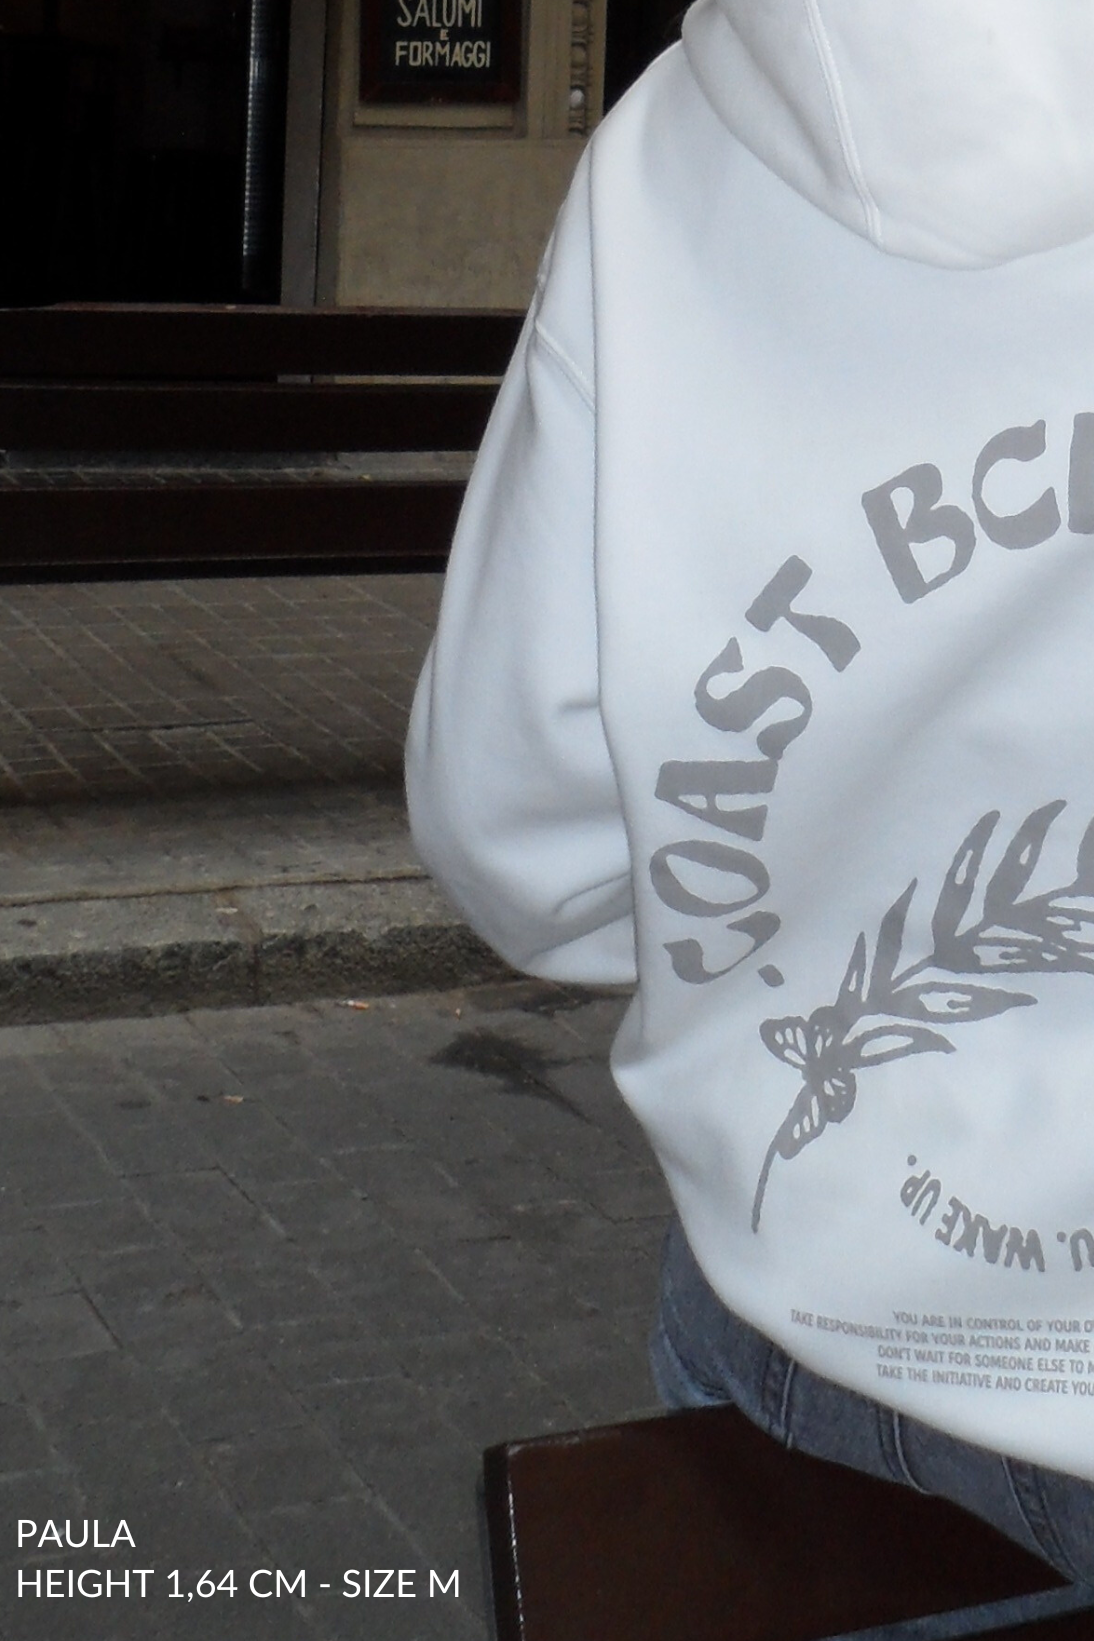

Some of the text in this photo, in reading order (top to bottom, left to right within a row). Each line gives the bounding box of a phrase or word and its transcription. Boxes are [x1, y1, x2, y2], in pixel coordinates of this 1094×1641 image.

[394, 40, 491, 68] FORMAGGI
[934, 1196, 1046, 1273] WAKE
[790, 1309, 813, 1327] TAKE
[816, 1315, 901, 1340] RESPONSIBILITY
[905, 1331, 928, 1344] FOR
[931, 1332, 965, 1346] YOUR
[968, 1336, 1021, 1350] ACTIONS
[1023, 1338, 1051, 1352] AND
[1055, 1339, 1090, 1354] MAKE
[893, 1311, 918, 1325] YOU
[921, 1314, 945, 1327] ARE
[948, 1316, 962, 1328] IN
[966, 1318, 1023, 1332] CONTROL
[1026, 1320, 1042, 1332] OF
[1047, 1320, 1080, 1333] YOUR
[877, 1345, 910, 1361] DON'T
[914, 1350, 944, 1364] WAIT
[948, 1352, 971, 1366] FOR
[974, 1355, 1034, 1371] SOMEONE
[1038, 1357, 1066, 1373] ELSE
[1069, 1360, 1085, 1374] TO
[876, 1364, 903, 1379] TAKE
[907, 1368, 928, 1382] THE
[932, 1369, 992, 1389] INITIATIVE
[995, 1375, 1022, 1392] AND
[1024, 1377, 1068, 1395] CREATE
